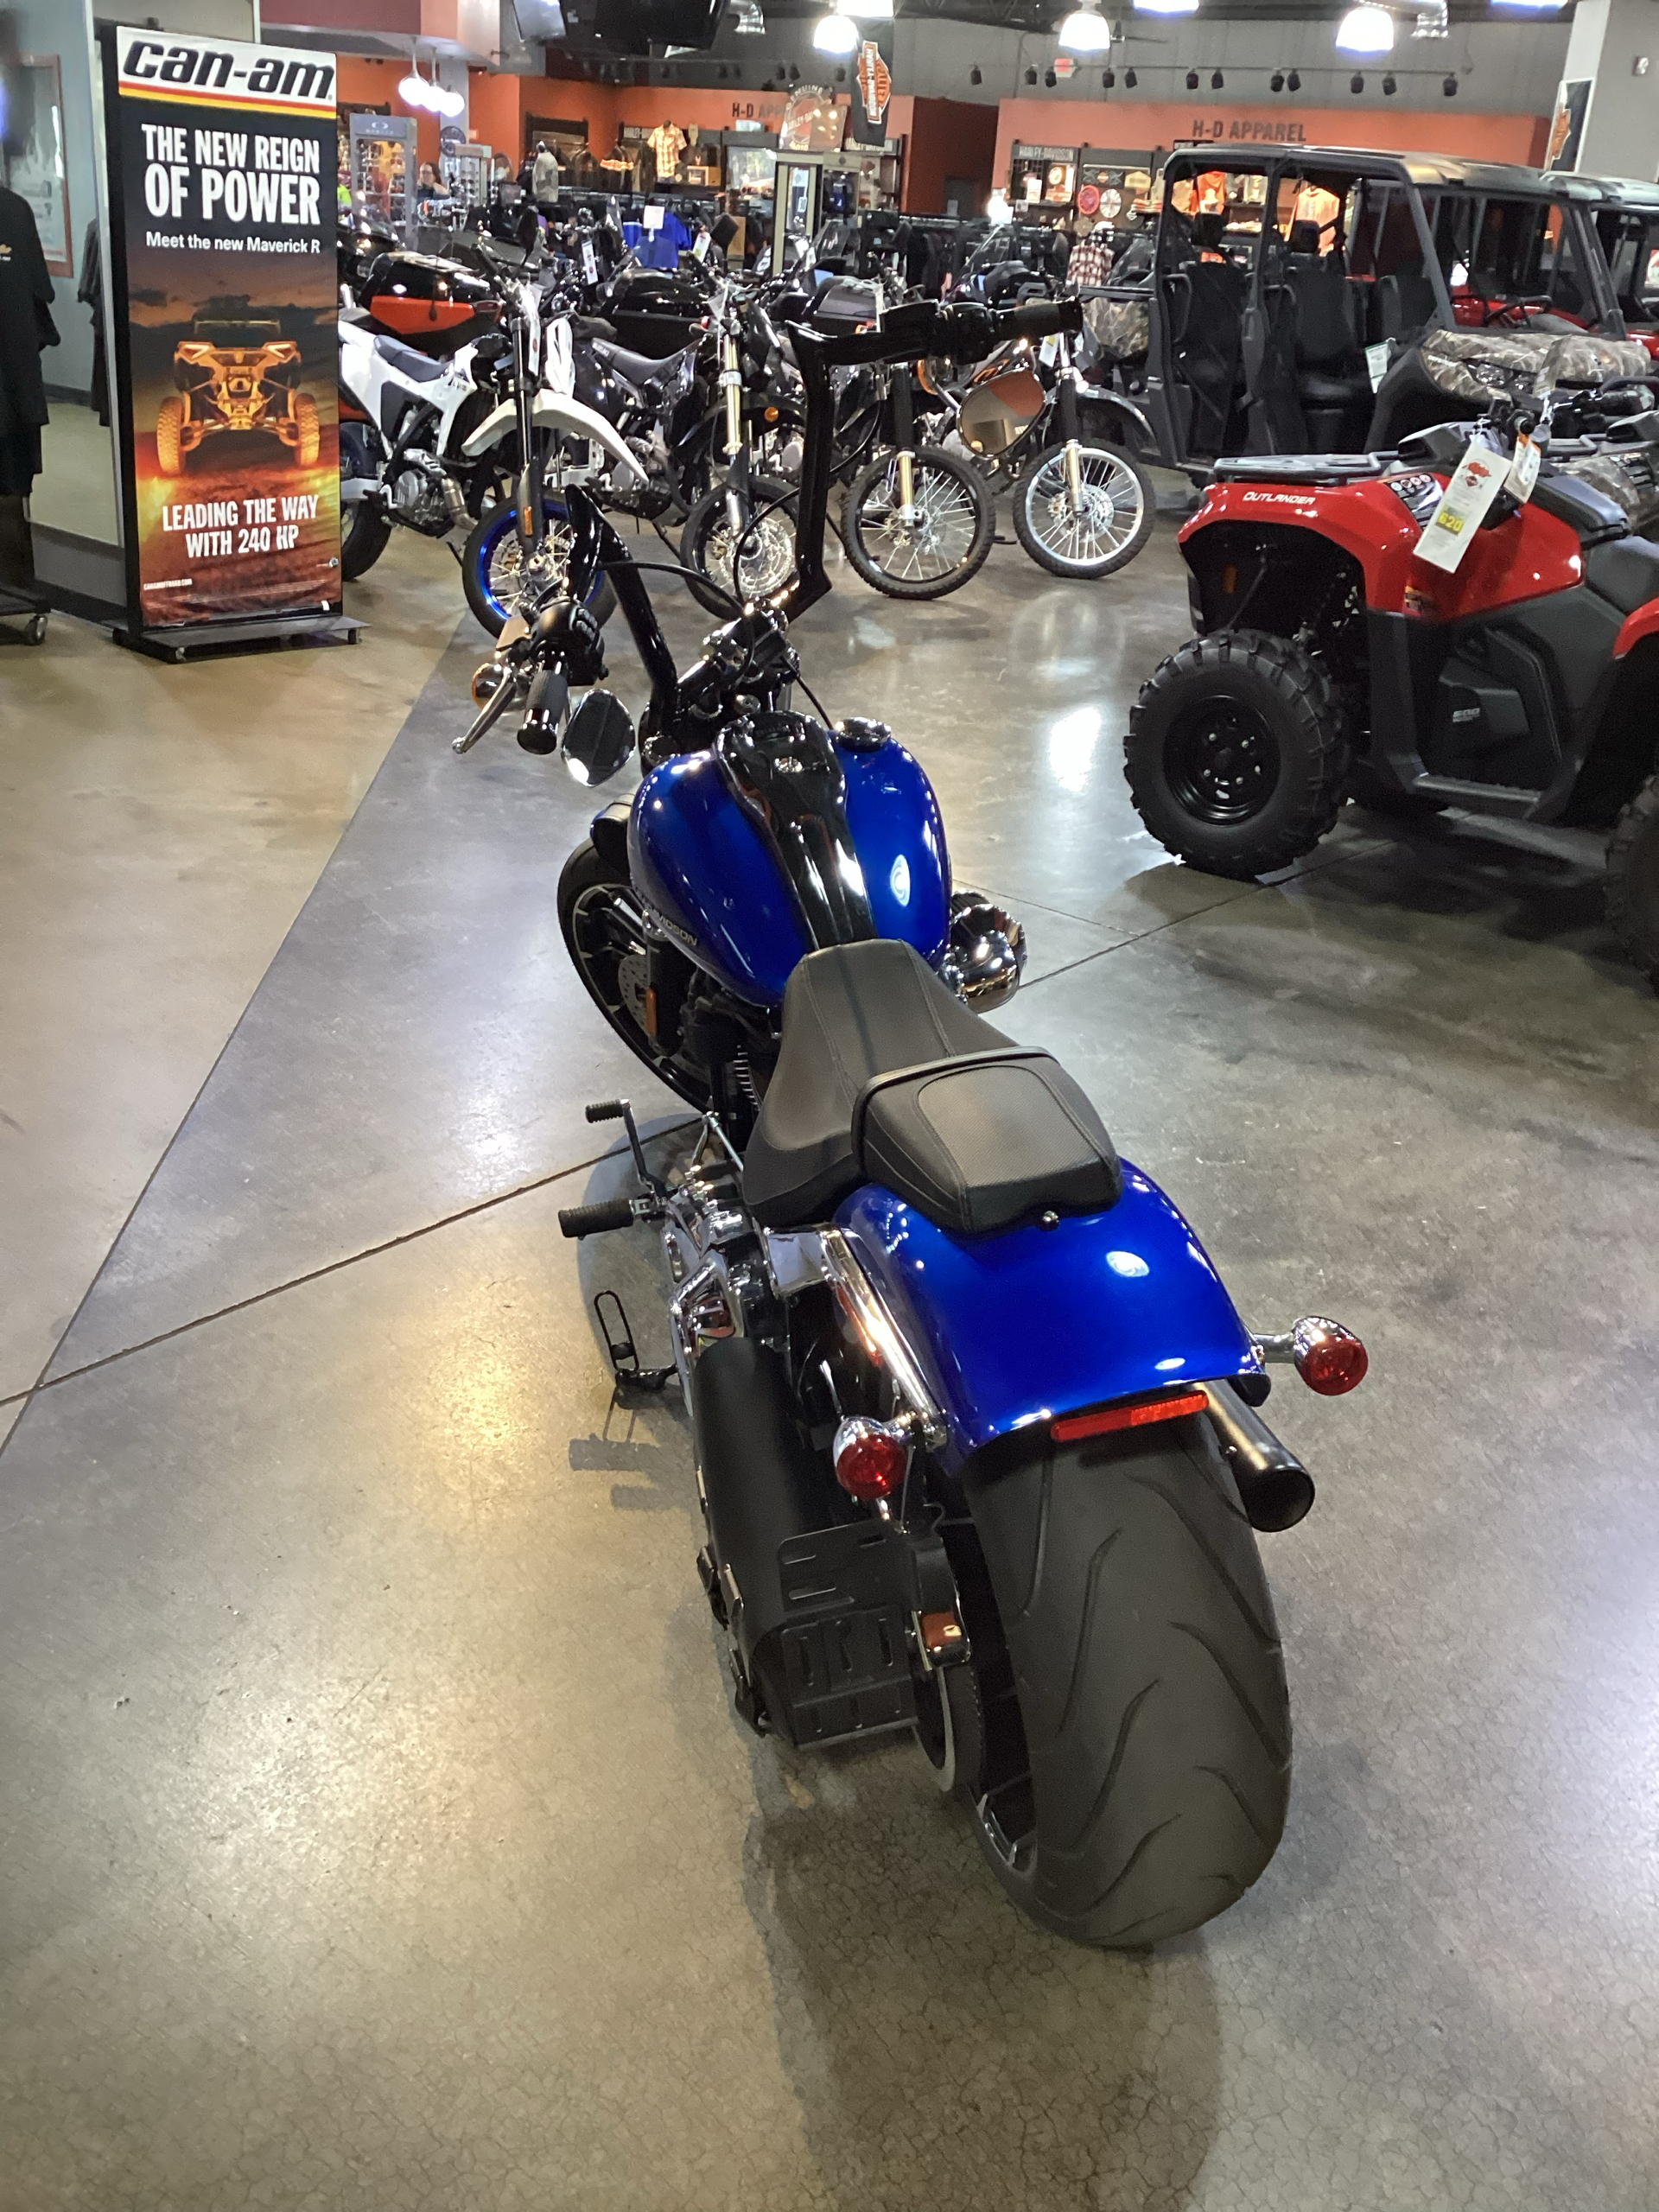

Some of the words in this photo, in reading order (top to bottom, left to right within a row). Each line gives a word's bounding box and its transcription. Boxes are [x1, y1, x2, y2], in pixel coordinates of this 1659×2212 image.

[123, 41, 335, 100] can-am
[732, 102, 753, 118] H-D
[1192, 120, 1224, 138] H-D
[1229, 121, 1306, 142] APPAREL
[142, 124, 188, 162] THE
[194, 130, 248, 168] NEW
[255, 135, 320, 174] REIGN
[144, 162, 190, 218] OF
[200, 168, 321, 226] POWER
[146, 232, 185, 249] Meet
[188, 234, 211, 251] the
[214, 238, 244, 251] new
[247, 236, 308, 253] Maverick
[311, 239, 321, 254] R
[1243, 491, 1315, 505] OUTLANDER
[162, 501, 238, 531] LEADING
[243, 498, 277, 524] THE
[282, 494, 320, 520] WAY
[1439, 512, 1465, 531] 620
[186, 531, 232, 558] WITH
[238, 528, 270, 554] 240
[276, 524, 300, 550] HP
